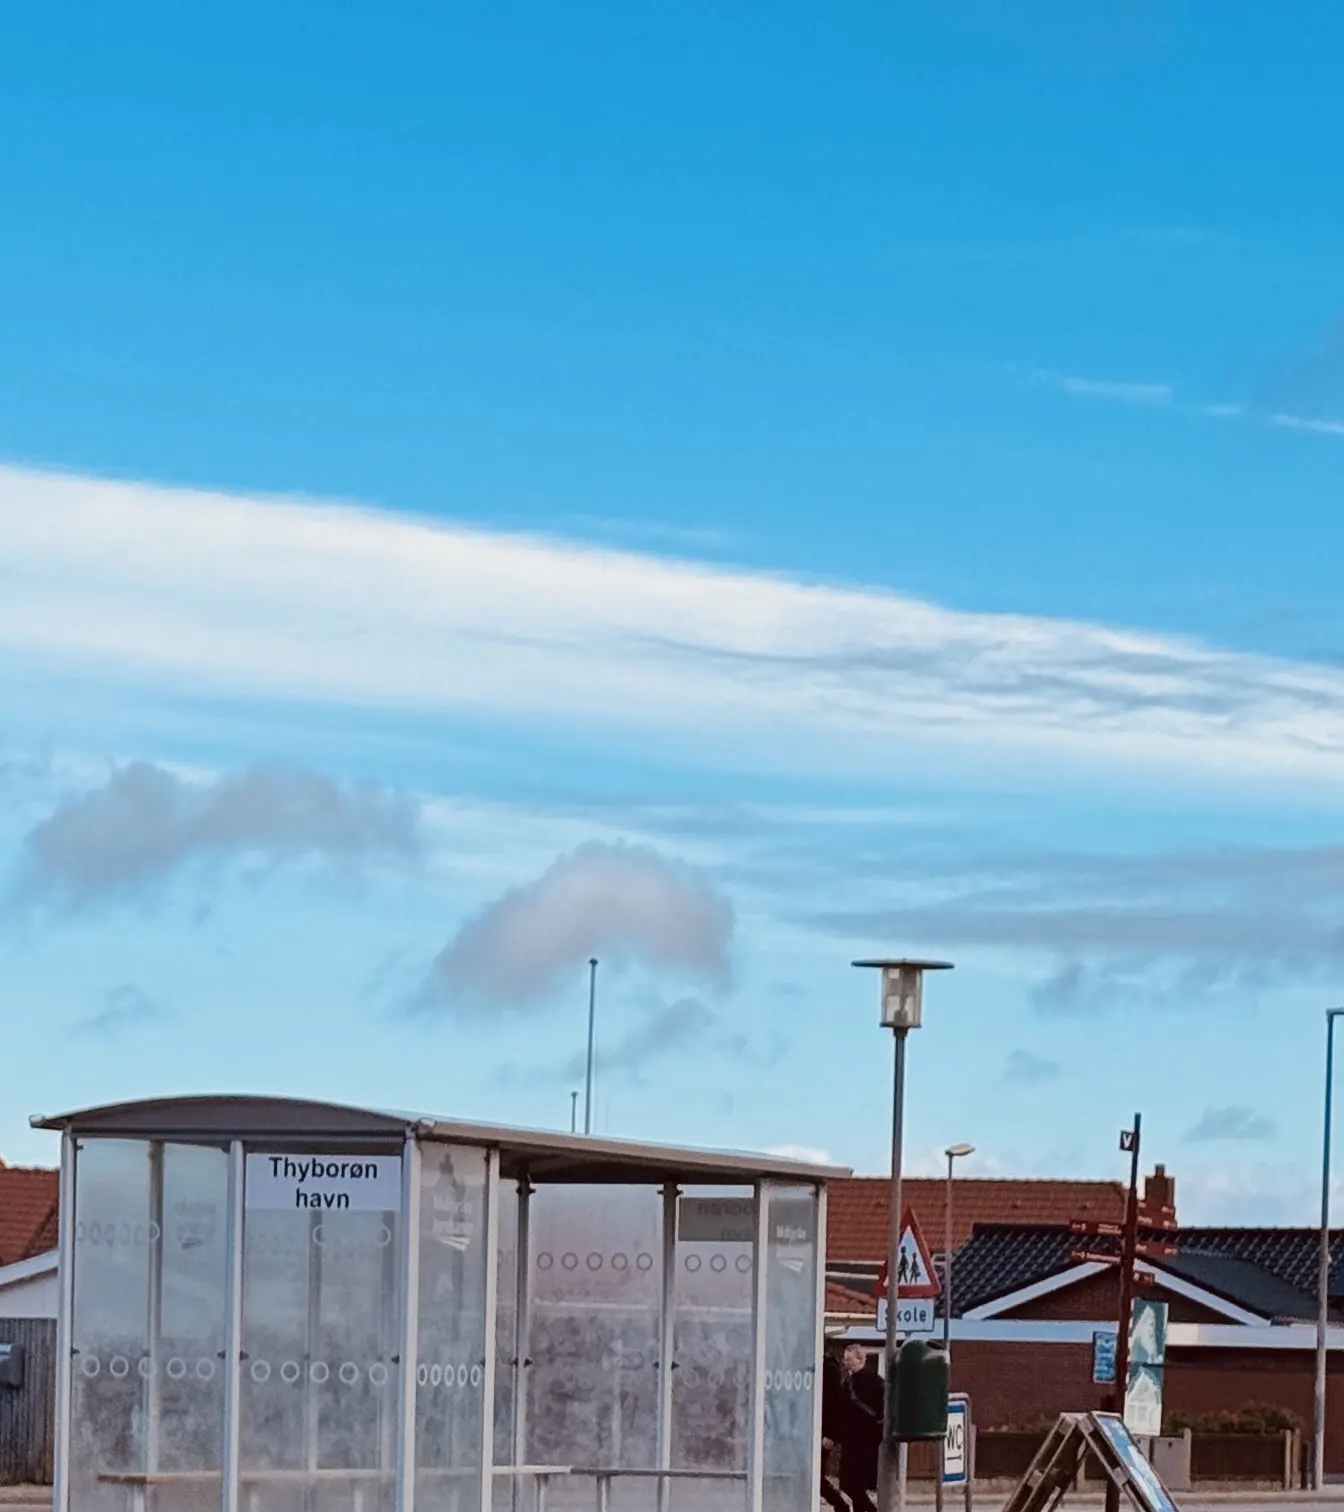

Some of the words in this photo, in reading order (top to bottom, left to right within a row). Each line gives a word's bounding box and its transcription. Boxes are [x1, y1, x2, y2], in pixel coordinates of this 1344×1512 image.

[269, 1156, 377, 1182] Thyborøn
[296, 1188, 349, 1208] havn
[947, 1424, 963, 1450] WC
